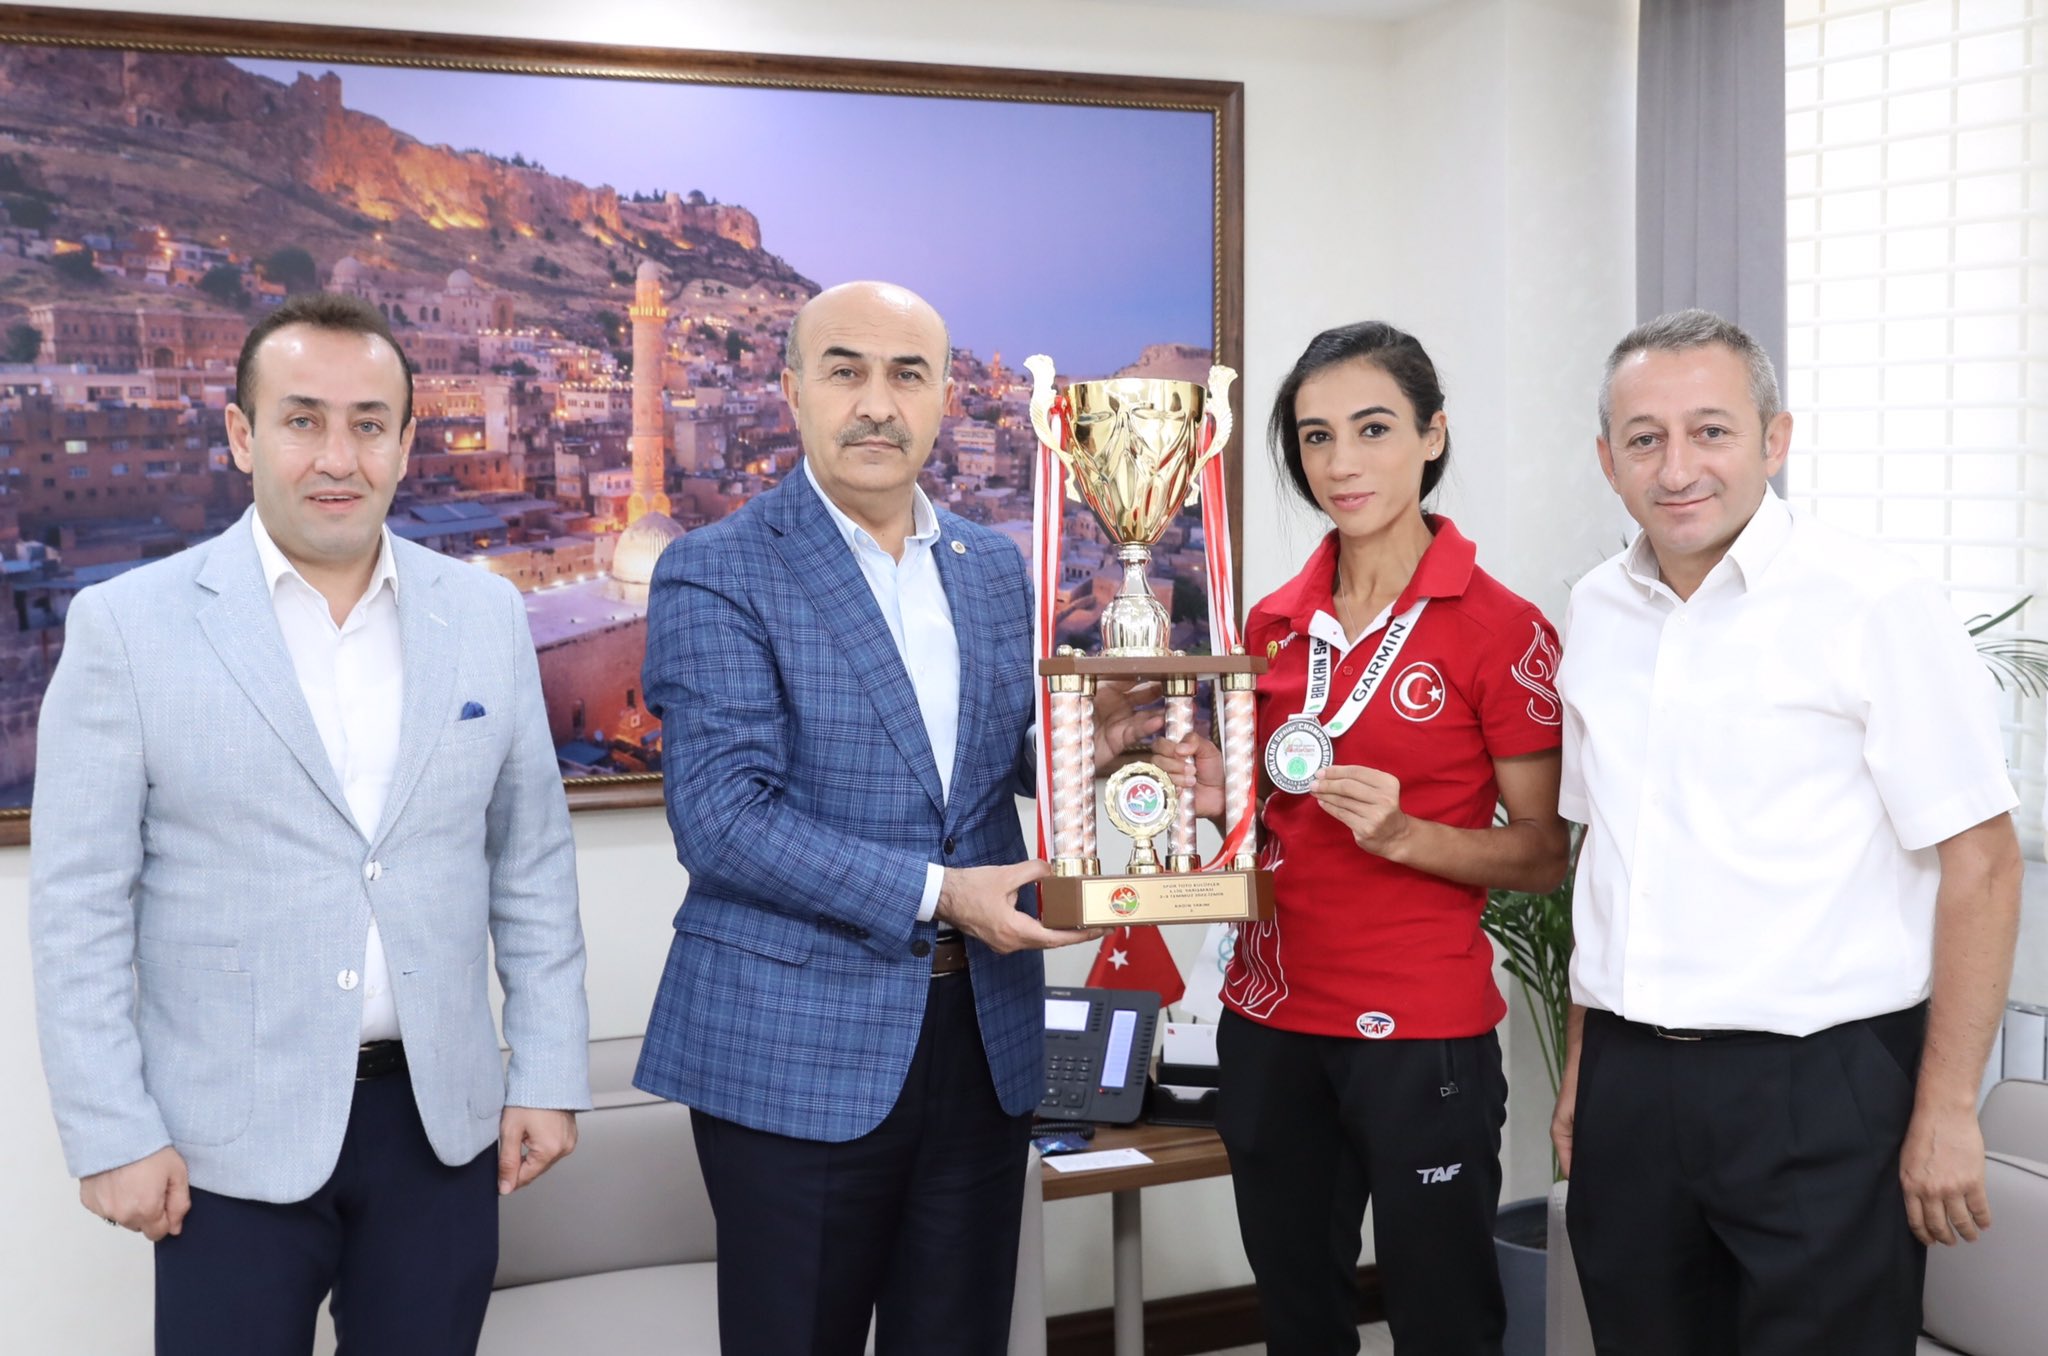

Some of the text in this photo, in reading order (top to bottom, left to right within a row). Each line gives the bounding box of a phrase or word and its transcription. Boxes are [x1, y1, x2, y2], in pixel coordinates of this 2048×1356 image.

[1311, 658, 1327, 699] BALKAN
[1352, 622, 1406, 702] GARMIN
[1268, 743, 1279, 778] BALKAN
[1363, 1023, 1390, 1035] TAF
[1416, 1163, 1462, 1184] TAF
